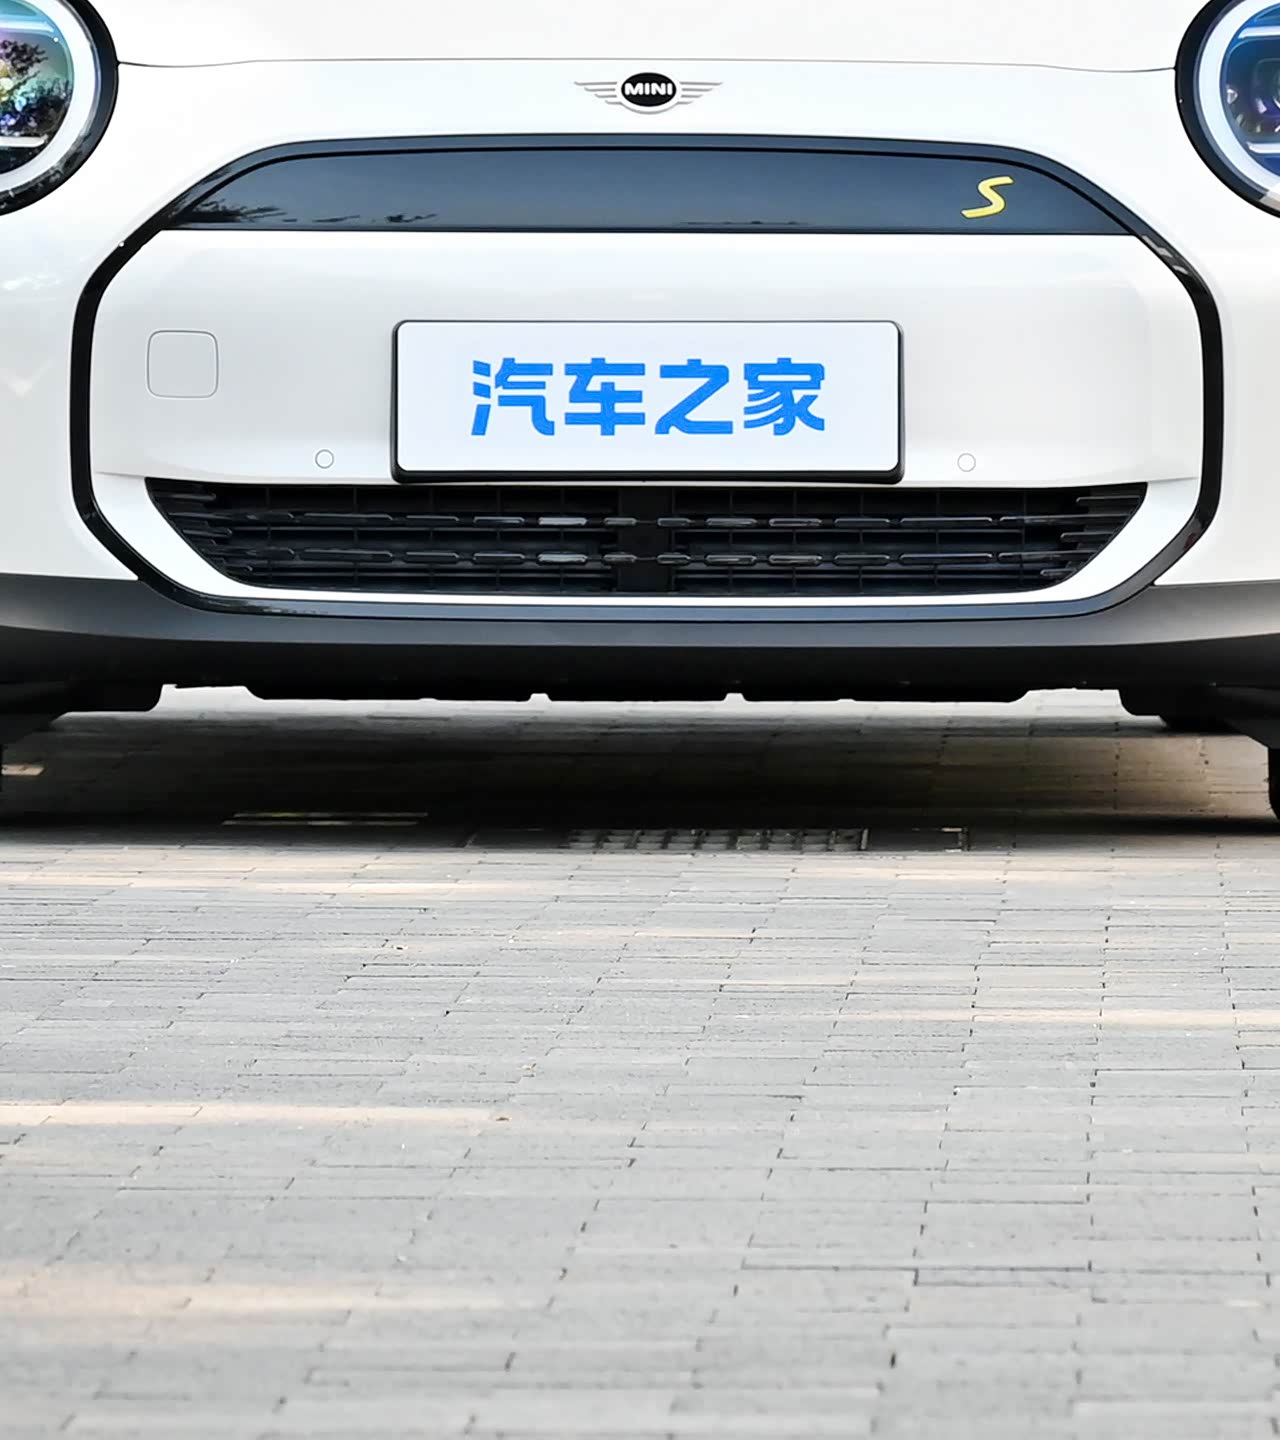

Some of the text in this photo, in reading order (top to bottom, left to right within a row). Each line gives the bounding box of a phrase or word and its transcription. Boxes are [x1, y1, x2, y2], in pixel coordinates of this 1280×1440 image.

[624, 82, 674, 96] MINI
[960, 175, 1014, 219] S
[470, 357, 826, 437] 汽车之家
